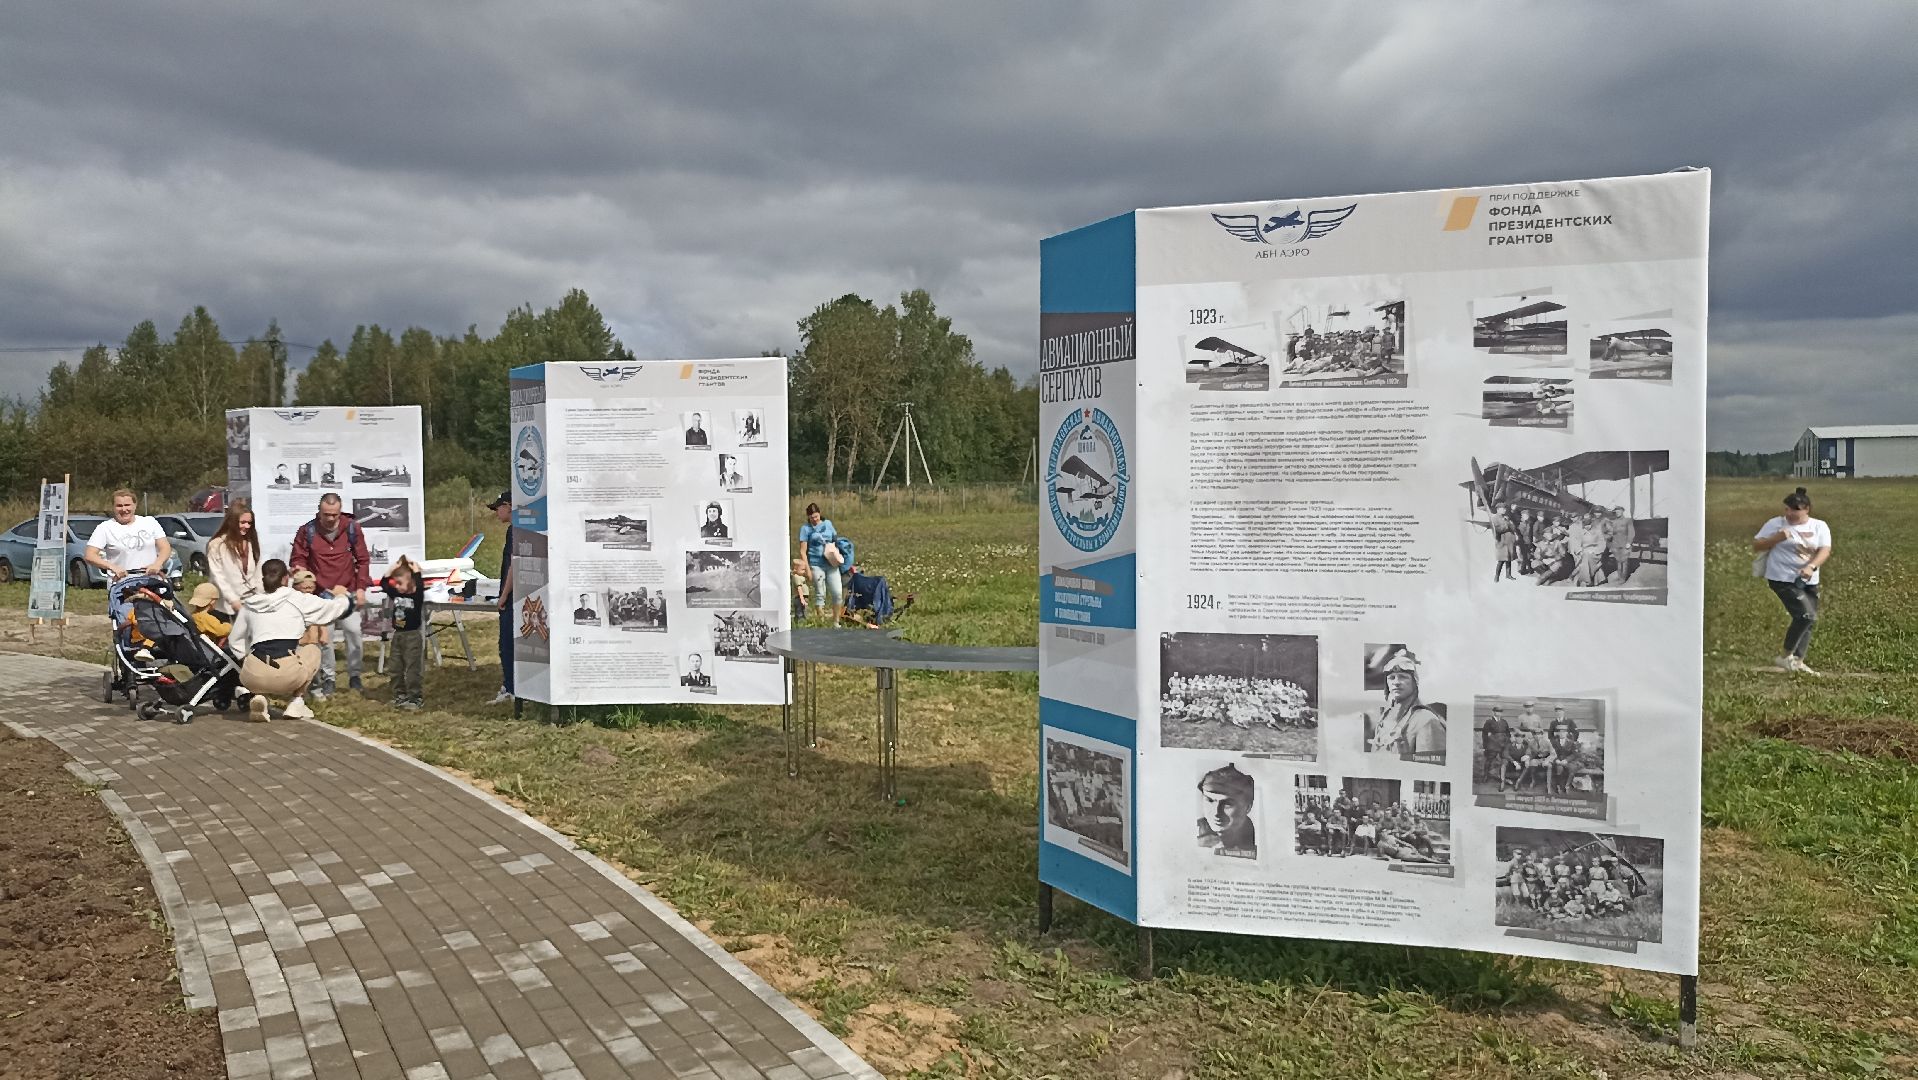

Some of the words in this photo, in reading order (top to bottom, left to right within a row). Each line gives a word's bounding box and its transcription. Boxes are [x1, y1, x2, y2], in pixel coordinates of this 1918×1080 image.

[1489, 194, 1510, 202] ПРИ
[1512, 190, 1580, 200] ПОДДЕРЖКЕ
[1488, 204, 1542, 216] ФОНДА
[1488, 215, 1612, 231] ПРЕЗИДЕНТСКИХ
[1488, 234, 1553, 246] ГРАНТОВ
[1255, 249, 1277, 259] АБН
[1280, 248, 1310, 258] АЭРО
[1190, 308, 1216, 325] 1923
[1219, 315, 1226, 324] г.
[1041, 317, 1133, 370] АВИАЦИОННЫЙ
[1042, 366, 1102, 404] СЕРПУХОВ
[1078, 442, 1096, 453] ШКОЛА
[1186, 594, 1214, 610] 1924
[1216, 601, 1223, 610] г.
